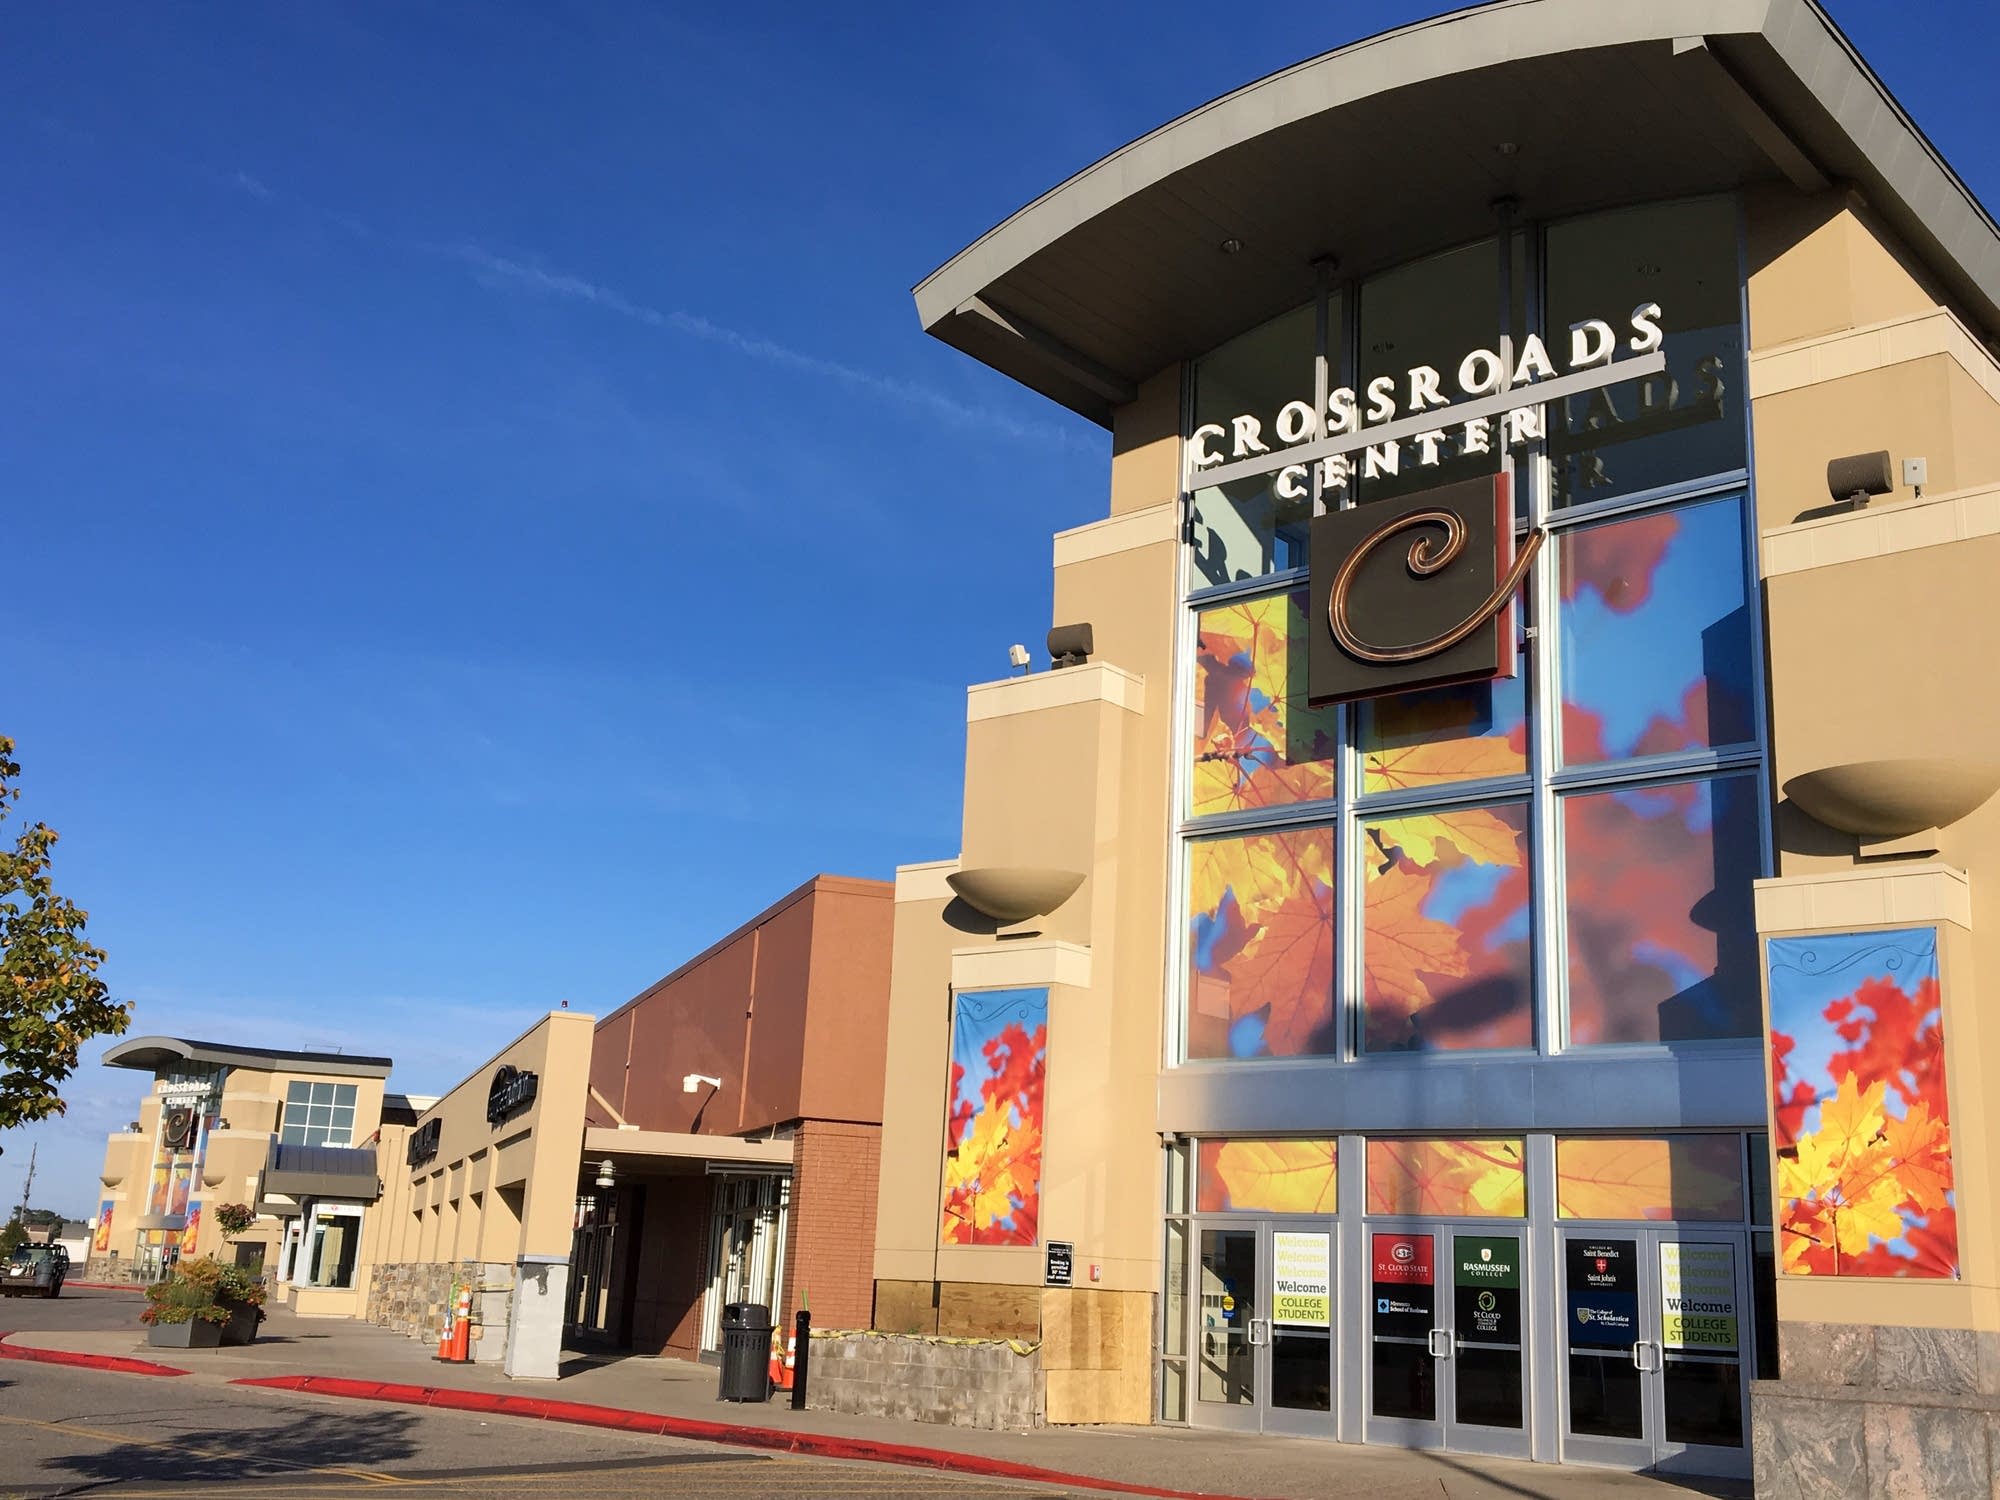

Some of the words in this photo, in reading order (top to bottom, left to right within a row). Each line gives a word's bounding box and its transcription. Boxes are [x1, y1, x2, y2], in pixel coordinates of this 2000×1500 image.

[1189, 303, 1664, 467] CROSSROADS
[1276, 406, 1545, 499] CENTER
[1277, 1236, 1328, 1248] Welcome
[1277, 1251, 1328, 1263] Welcome
[1583, 1249, 1596, 1257] Saint
[1597, 1249, 1619, 1258] Benedict
[1665, 1248, 1729, 1259] Welcome
[1277, 1266, 1328, 1278] Welcome
[1387, 1263, 1409, 1272] CLOUD
[1410, 1264, 1428, 1273] STATE
[1463, 1262, 1510, 1273] RASMUSSEN
[1665, 1264, 1730, 1277] Welcome
[1587, 1273, 1600, 1282] Saint
[1277, 1281, 1327, 1293] Welcome
[1666, 1281, 1731, 1295] Welcome
[1281, 1298, 1323, 1308] COLLEGE
[1666, 1298, 1732, 1313] Welcome
[1278, 1309, 1325, 1320] STUDENTS
[1481, 1311, 1501, 1320] CLOUD
[1597, 1314, 1629, 1322] Scholastica
[1673, 1318, 1728, 1330] COLLEGE
[1670, 1330, 1732, 1343] STUDENTS
